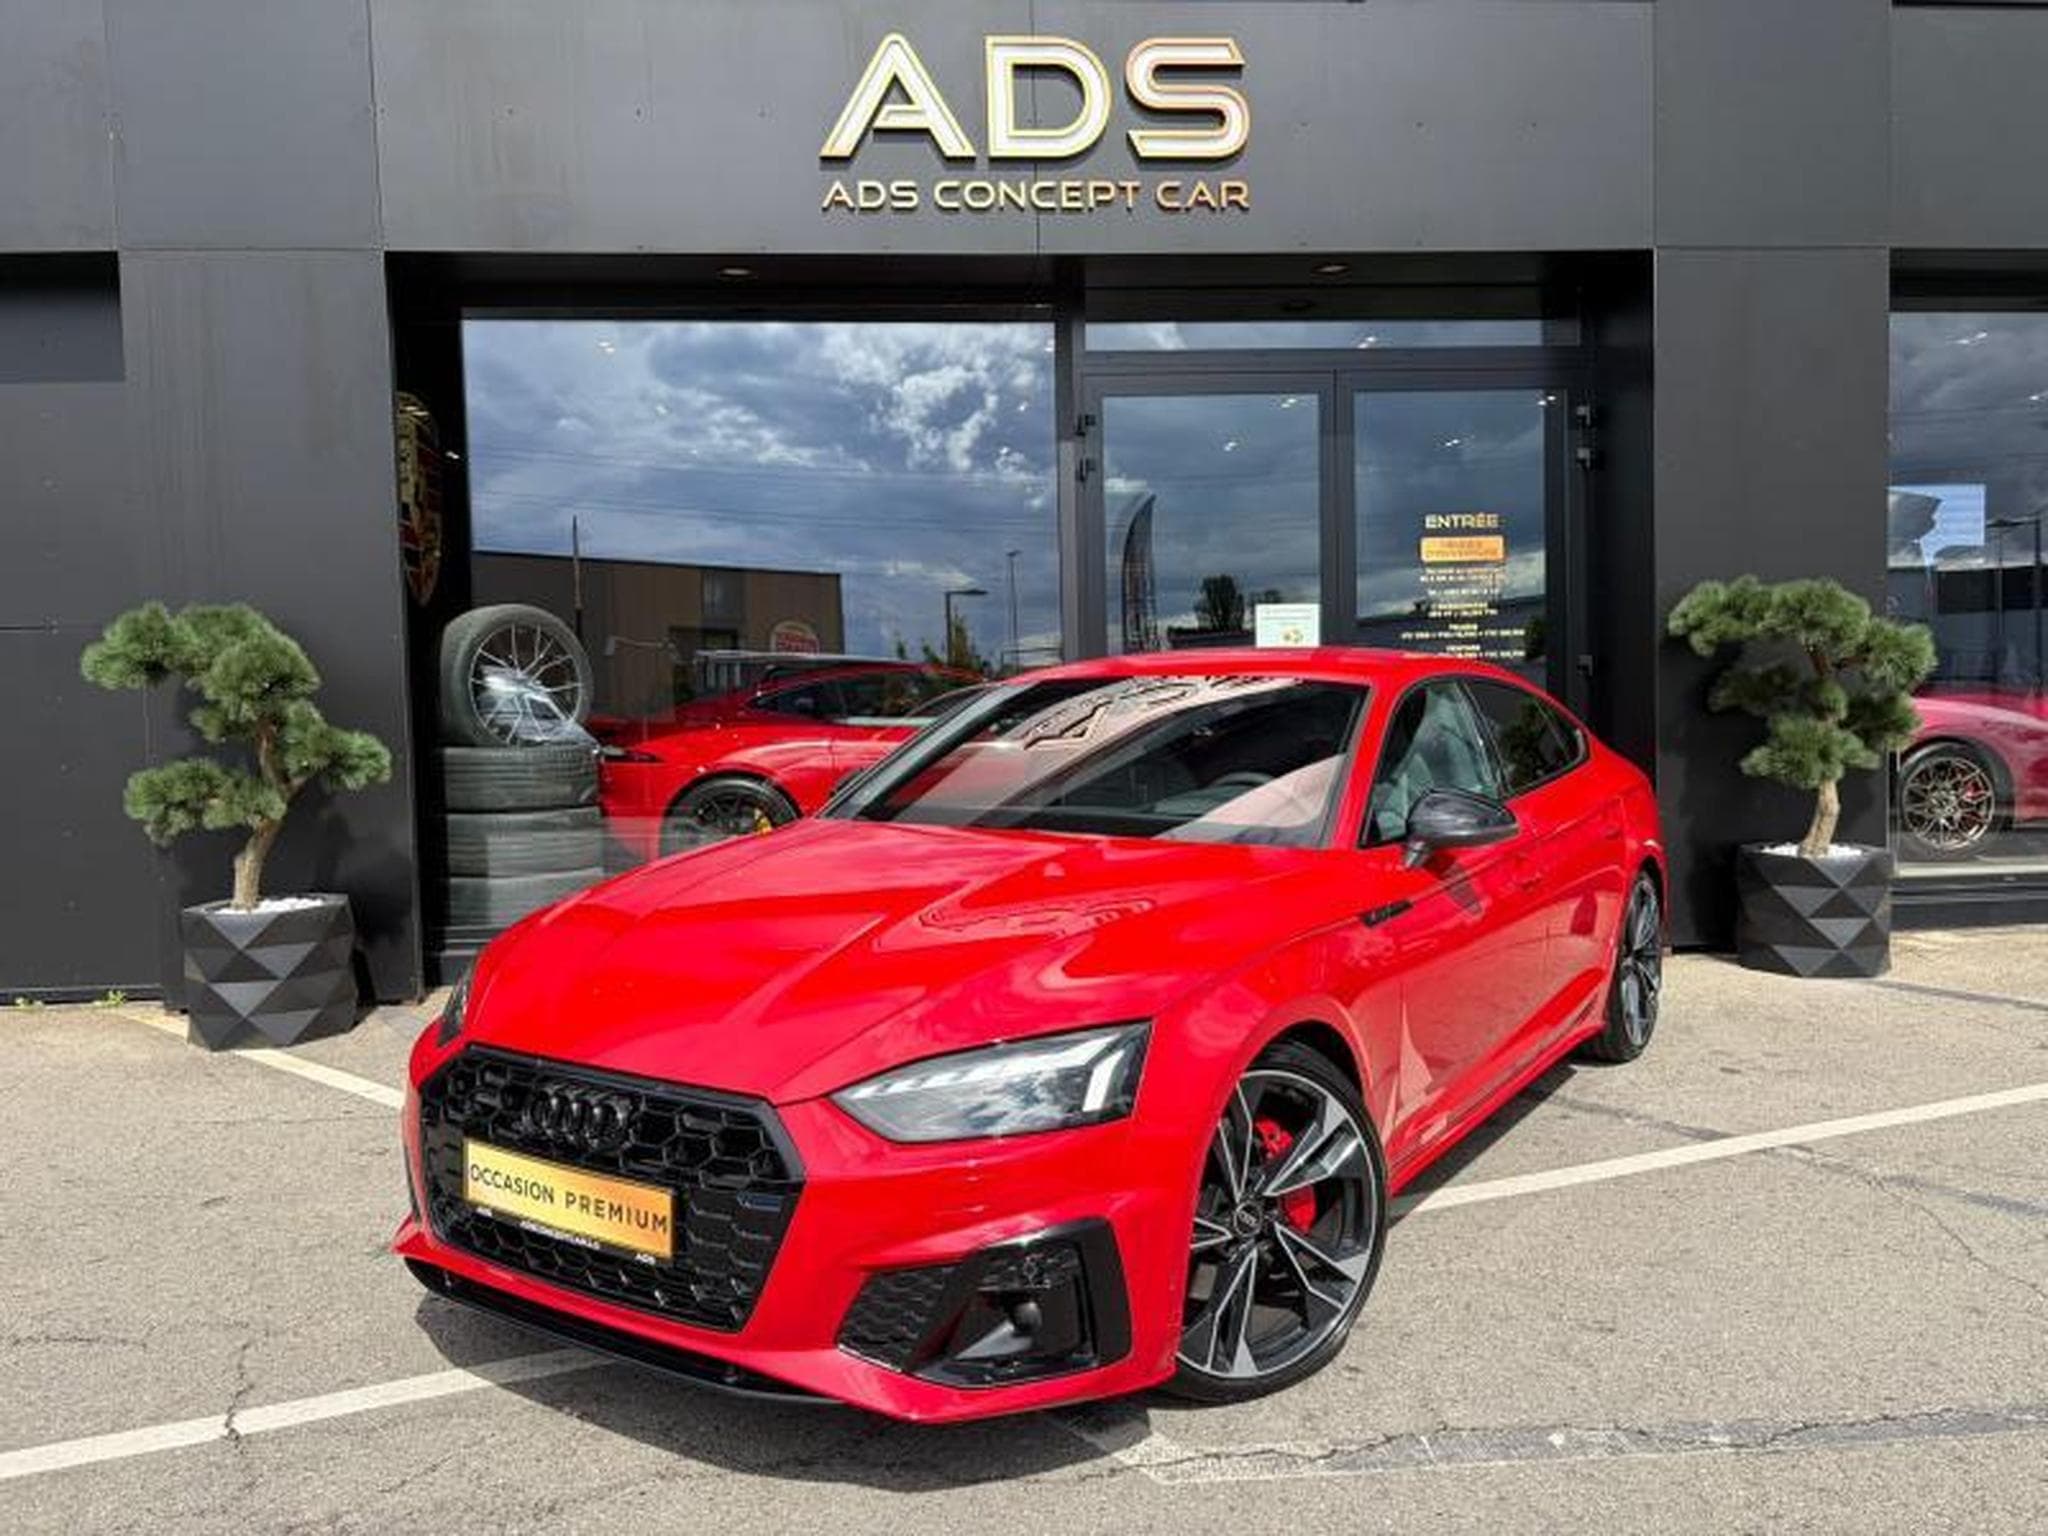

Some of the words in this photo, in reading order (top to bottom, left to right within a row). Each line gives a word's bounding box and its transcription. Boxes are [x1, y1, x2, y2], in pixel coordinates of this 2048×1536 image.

[819, 32, 1251, 158] ADS
[821, 181, 917, 210] ADS
[933, 181, 1141, 210] CONCEPT
[1156, 180, 1251, 210] CAR
[1424, 511, 1499, 529] ENTRÉE
[469, 1162, 555, 1205] OCCASION
[564, 1190, 668, 1234] PREMIUM
